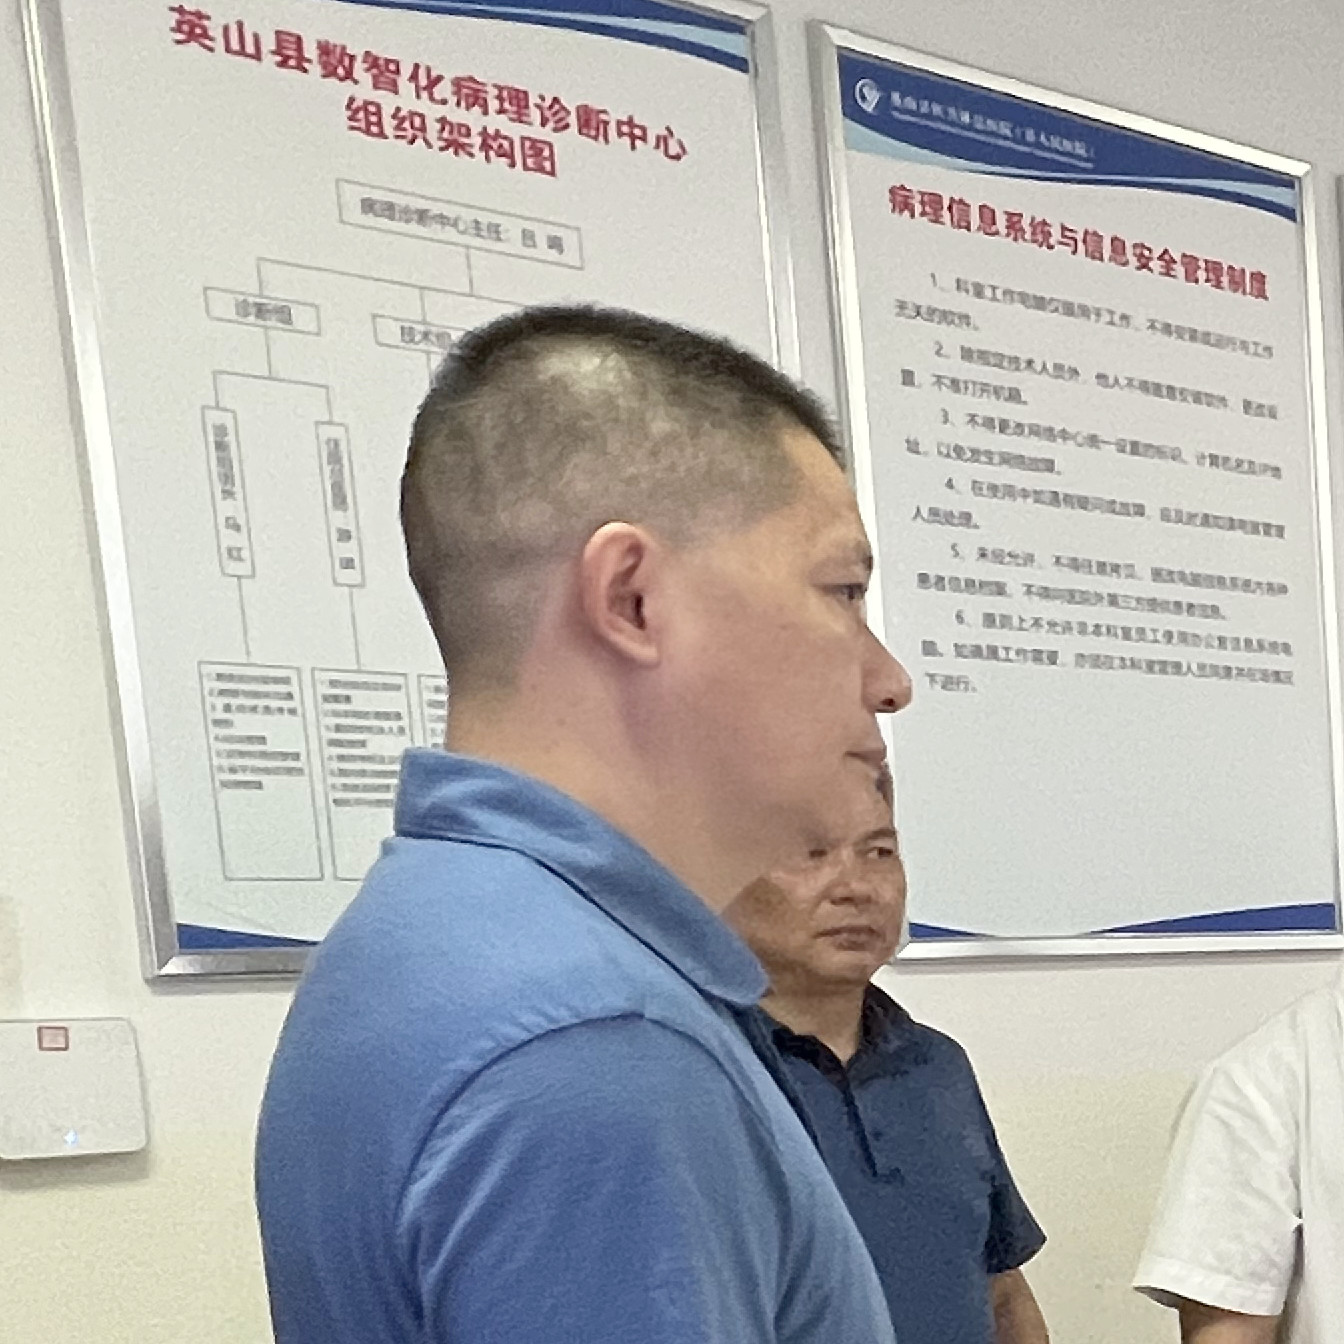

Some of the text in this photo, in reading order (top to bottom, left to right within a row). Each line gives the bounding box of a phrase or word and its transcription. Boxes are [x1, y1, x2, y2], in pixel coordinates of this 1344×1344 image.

[168, 5, 688, 162] 英山县数智化病理诊断中心
[345, 95, 557, 178] 组织架构图
[889, 184, 1269, 300] 病理信息系统与信息安全管理制度
